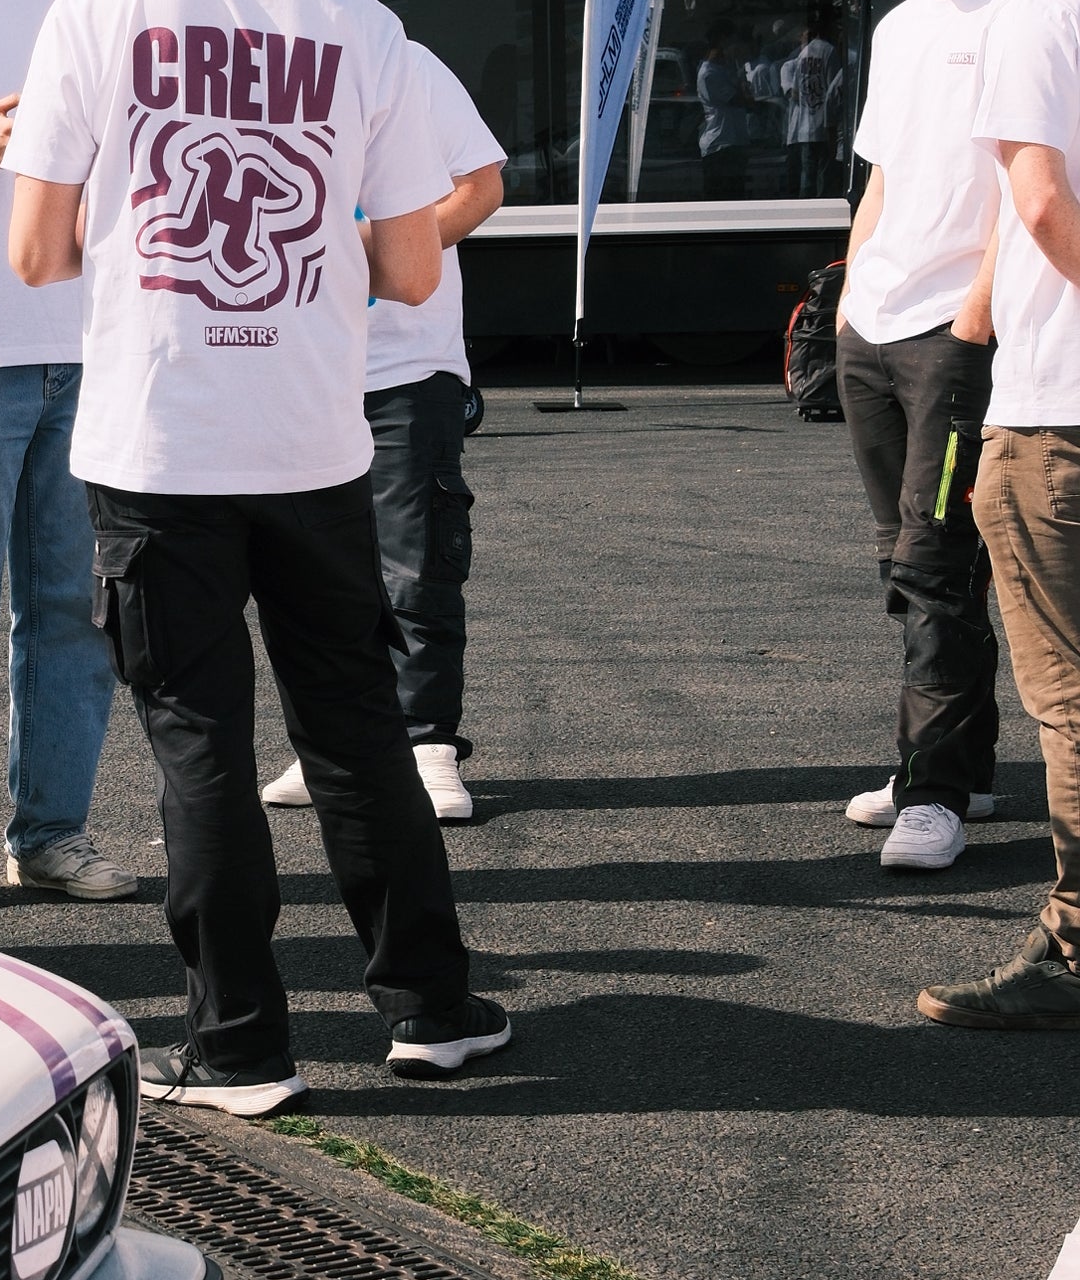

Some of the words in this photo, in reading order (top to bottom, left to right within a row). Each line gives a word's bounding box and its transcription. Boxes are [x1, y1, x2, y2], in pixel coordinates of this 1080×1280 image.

[132, 25, 343, 124] CREW
[205, 326, 279, 348] HFMSTRS
[17, 1173, 66, 1248] NAPA
